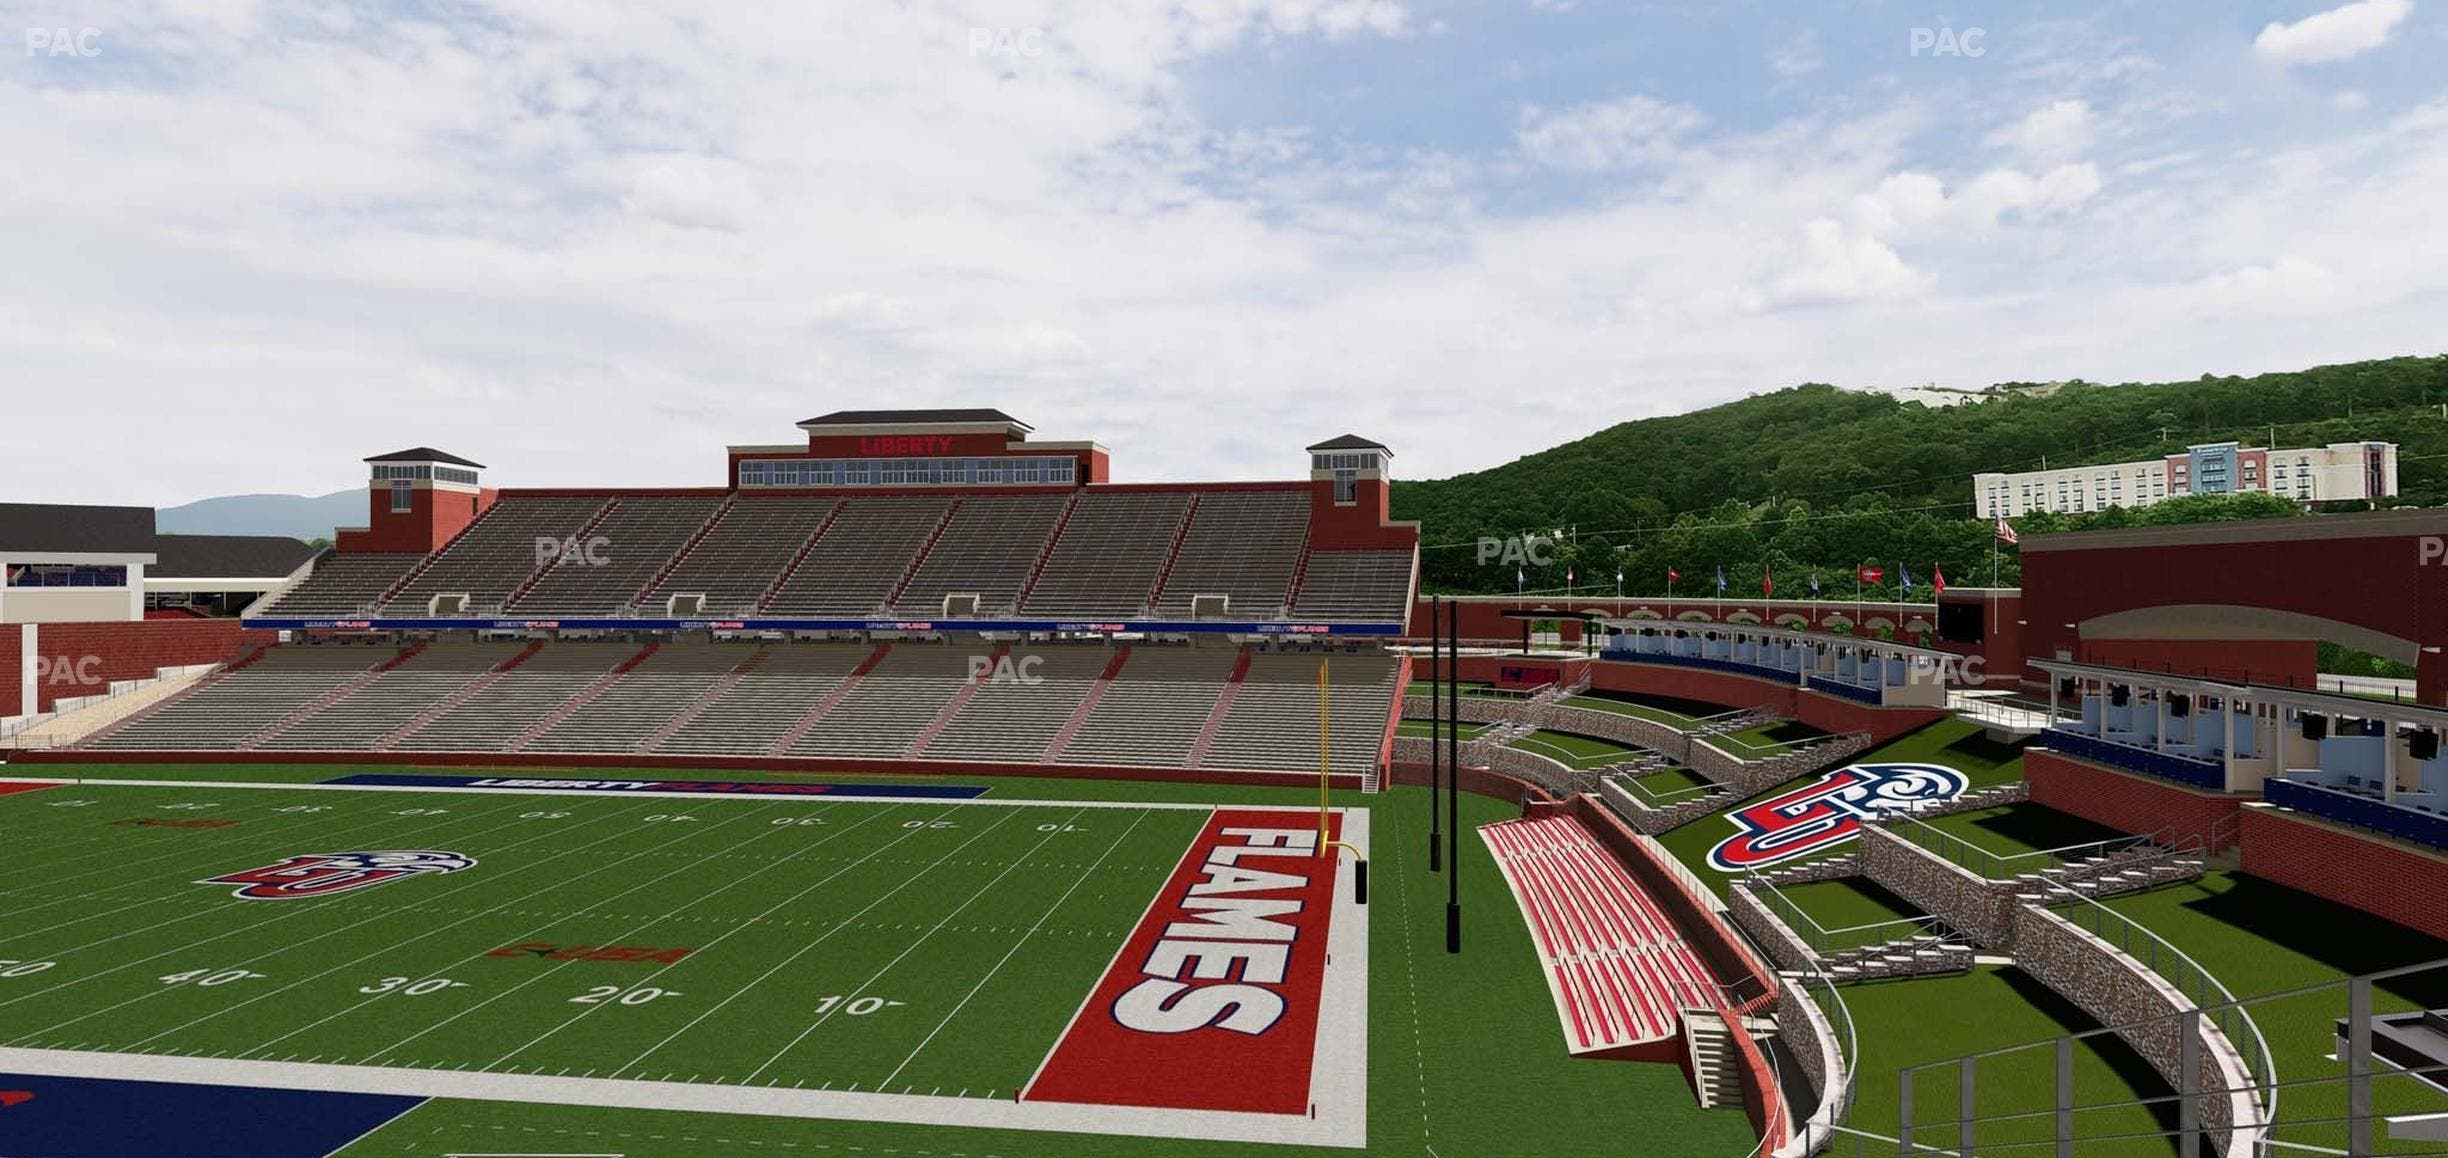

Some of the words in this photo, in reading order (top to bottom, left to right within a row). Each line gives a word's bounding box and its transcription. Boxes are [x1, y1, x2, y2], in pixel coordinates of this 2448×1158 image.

[860, 434, 953, 456] LIBERTY
[466, 778, 662, 789] LIBERTY
[1110, 826, 1319, 1036] FLAMES
[158, 968, 250, 986] 40
[359, 976, 451, 995] 30
[566, 985, 662, 1006] 20
[813, 995, 885, 1016] 10
